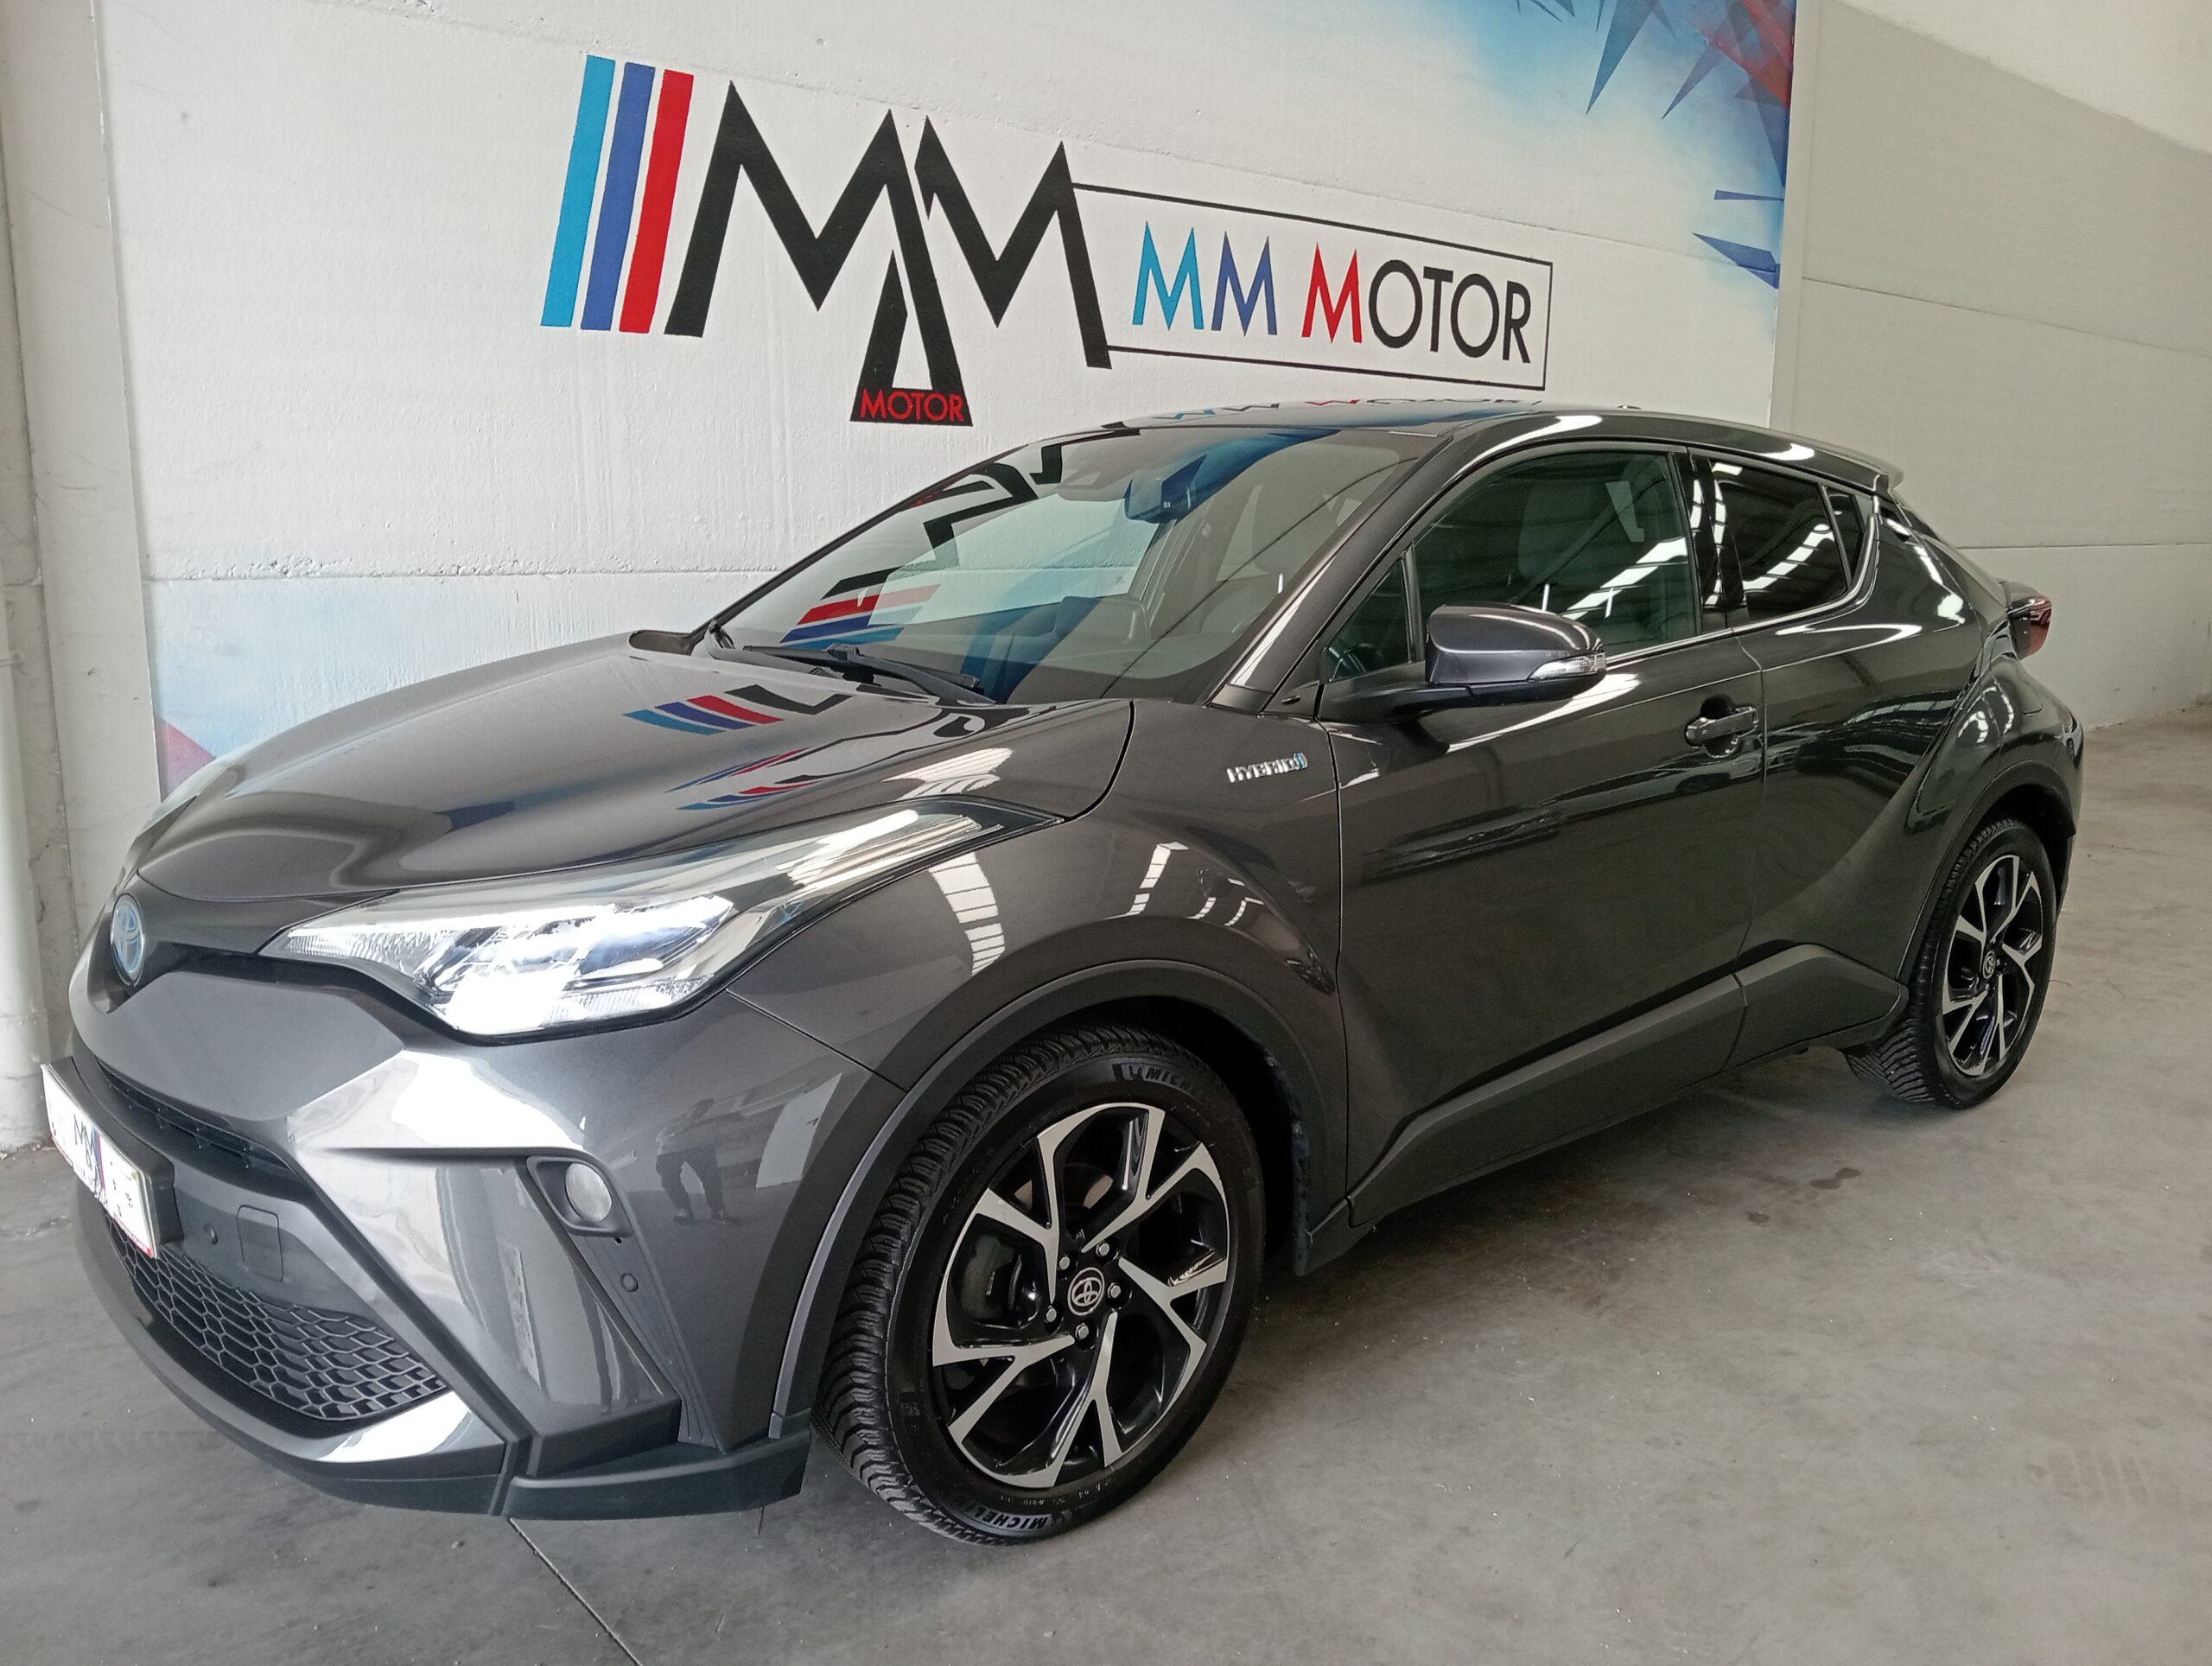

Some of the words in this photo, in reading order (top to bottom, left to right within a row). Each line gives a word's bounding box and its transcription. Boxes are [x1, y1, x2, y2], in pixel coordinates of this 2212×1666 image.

[1132, 220, 1278, 337] MM
[1300, 242, 1532, 364] MOTOR
[860, 387, 965, 423] MOTOR
[1226, 758, 1300, 783] HYBRID
[962, 1501, 1048, 1529] MICHEL
